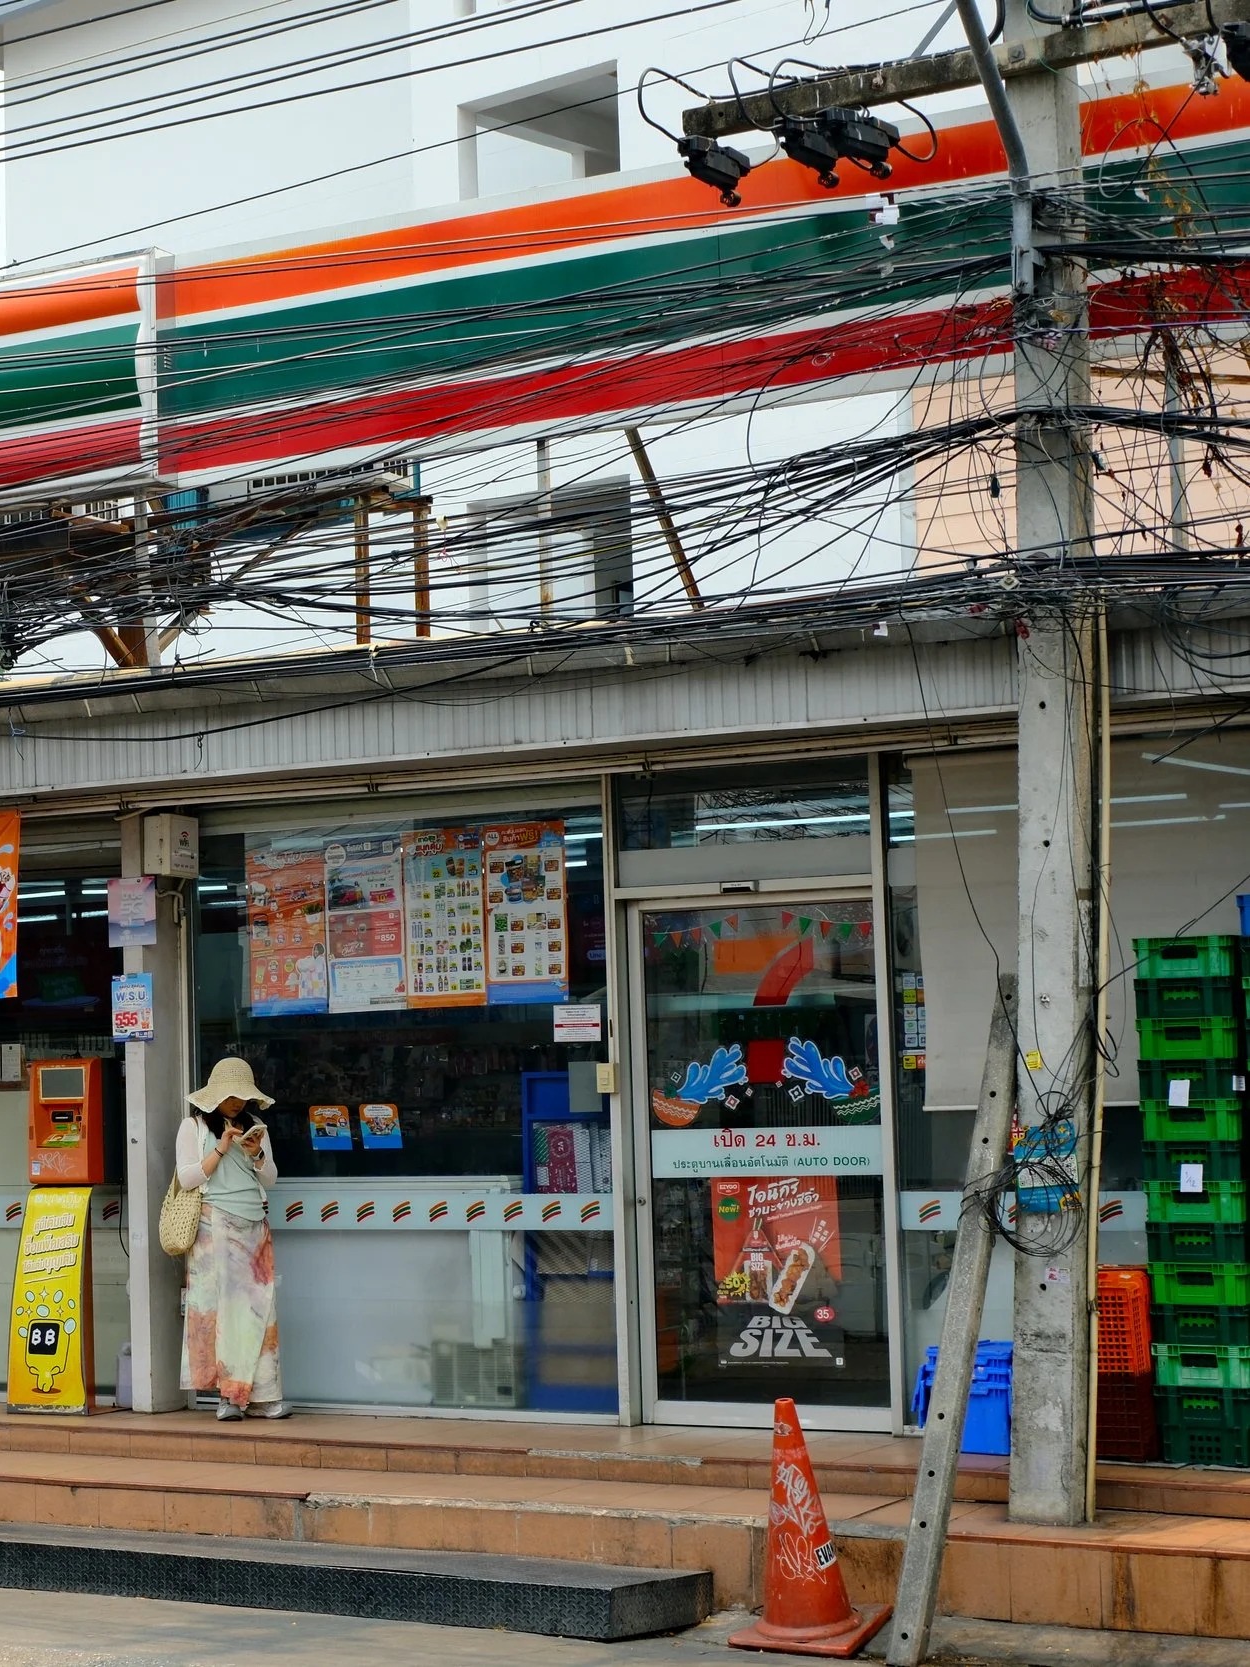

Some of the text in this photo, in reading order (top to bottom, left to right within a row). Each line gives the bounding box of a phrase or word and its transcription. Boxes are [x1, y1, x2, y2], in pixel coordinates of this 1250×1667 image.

[380, 933, 396, 942] 850
[115, 1011, 138, 1027] 555
[713, 1128, 821, 1148] เปิด 24 ข.ม.
[673, 1154, 870, 1172] ประตูบานเลื่อนอัตโนมัติ (AUTO DOOR)
[718, 1203, 740, 1214] New!
[751, 1253, 763, 1262] BIG
[751, 1262, 765, 1271] SIZE
[816, 1309, 829, 1319] 35
[746, 1315, 808, 1329] BIG
[729, 1328, 833, 1358] SIZE
